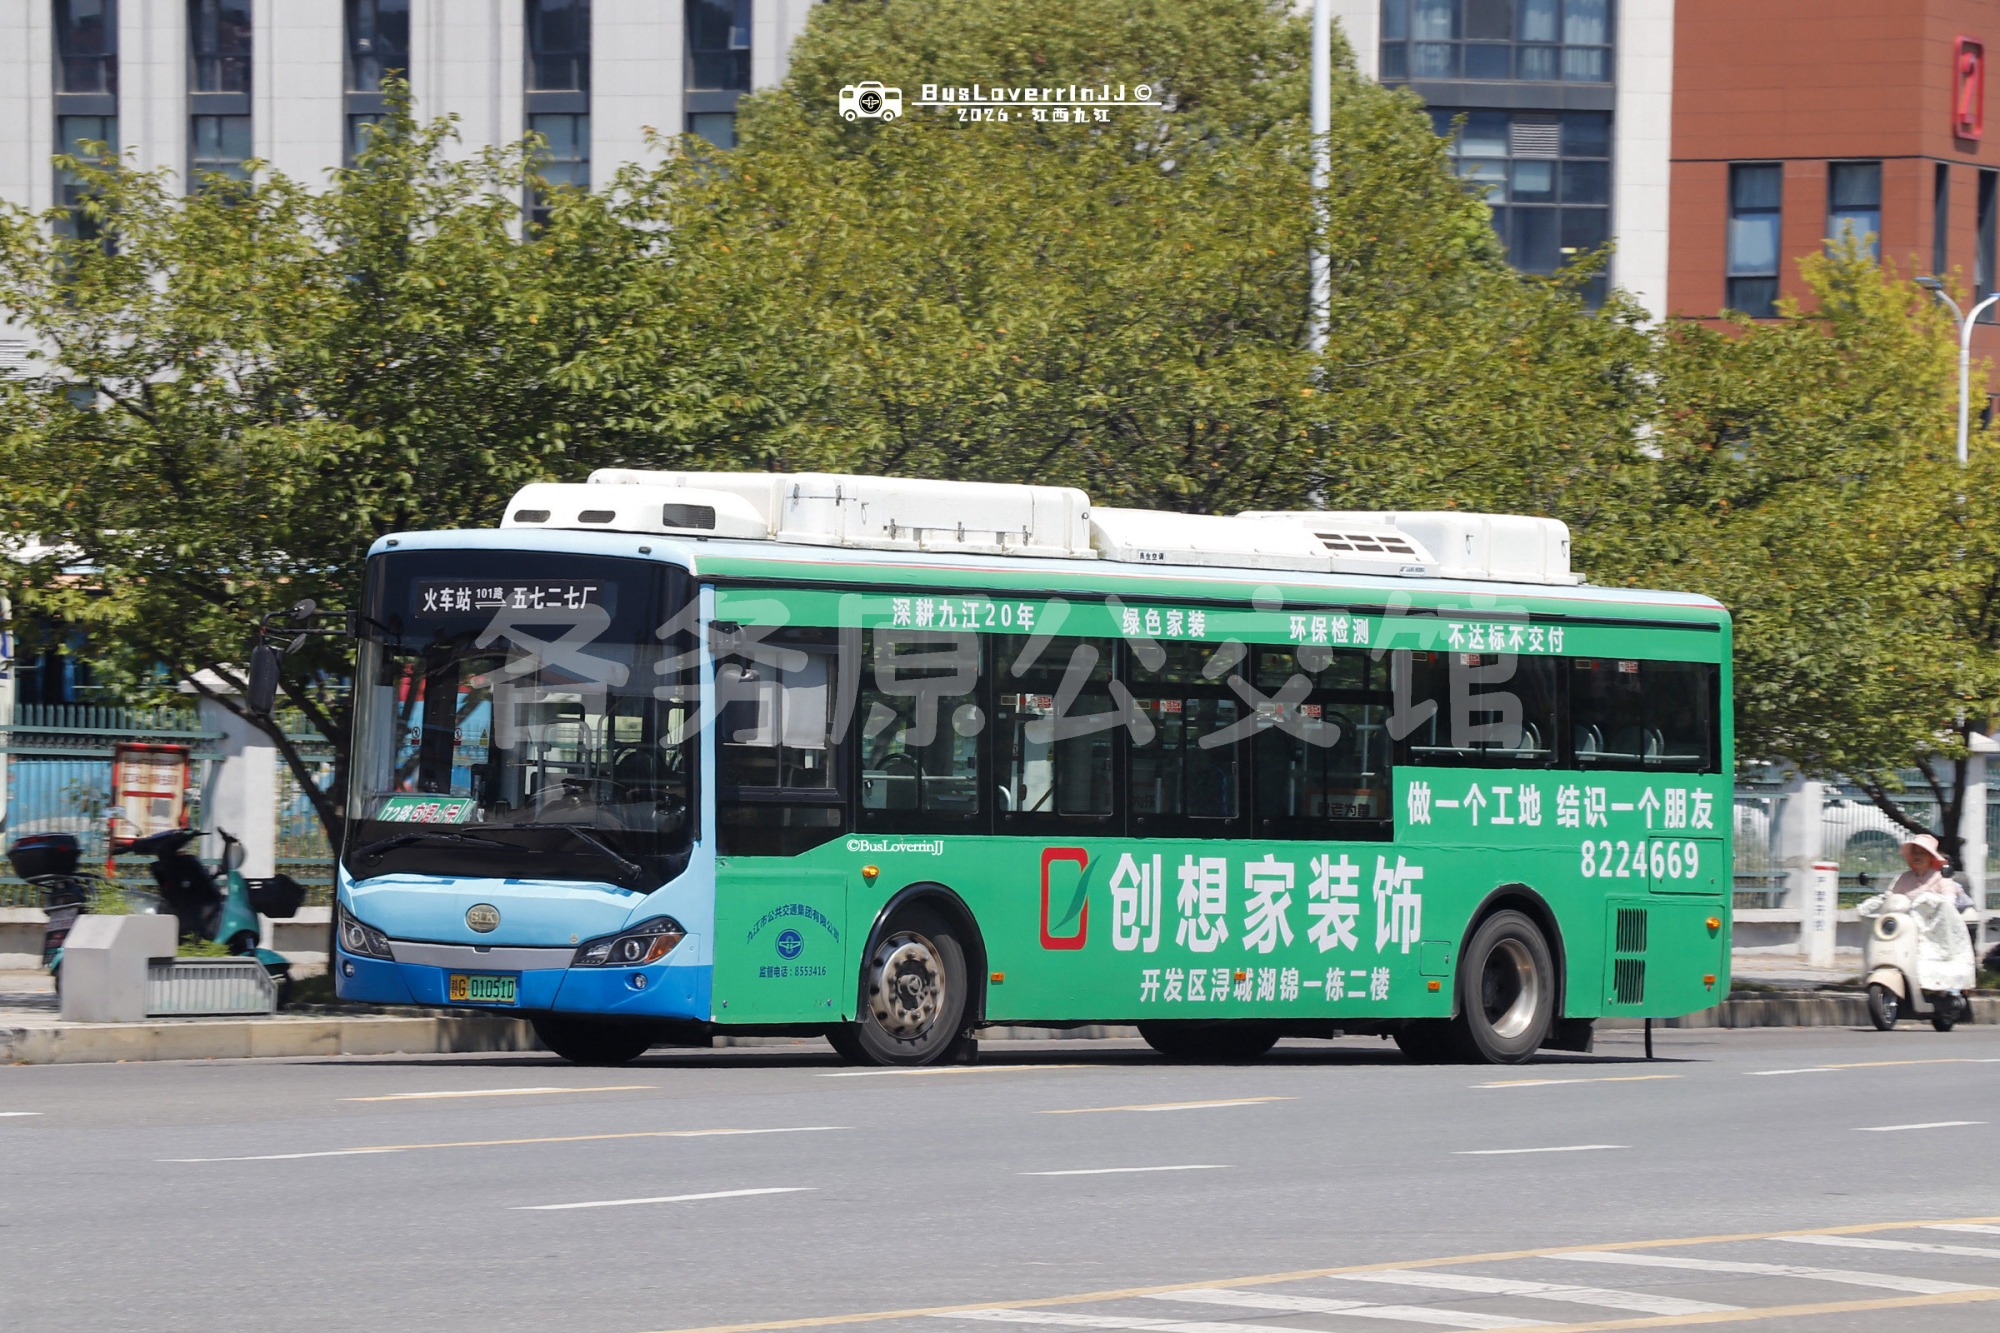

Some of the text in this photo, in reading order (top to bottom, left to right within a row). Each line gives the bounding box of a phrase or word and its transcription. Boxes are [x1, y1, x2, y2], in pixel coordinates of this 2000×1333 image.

[422, 586, 598, 612] 火车站 101路 五七二七厂
[892, 597, 1564, 653] 深耕九江20年 绿色家装 环保检测 不达标不交付
[1407, 781, 1713, 829] 做一个工地 结识一个朋友
[1581, 840, 1699, 879] 8224669
[1109, 853, 1424, 954] 创想家装饰
